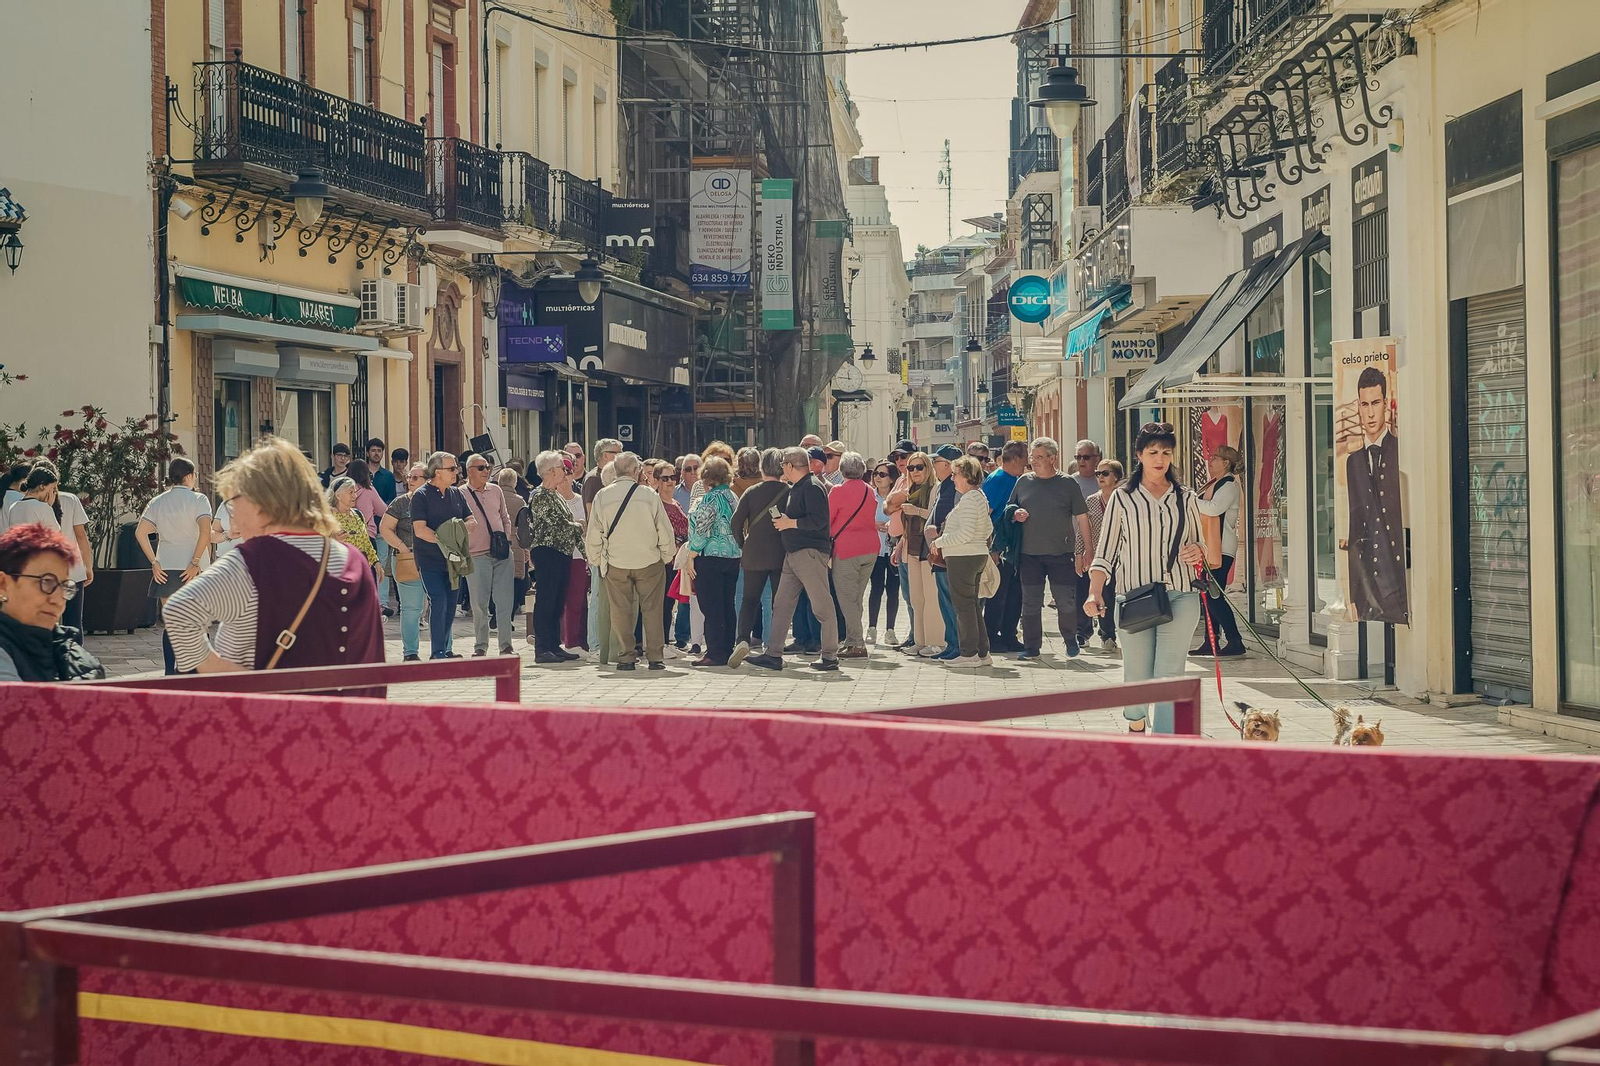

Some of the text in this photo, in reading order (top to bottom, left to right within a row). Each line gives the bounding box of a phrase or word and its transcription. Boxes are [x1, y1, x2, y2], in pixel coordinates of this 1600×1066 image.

[692, 274, 747, 282] 634 859 477
[212, 285, 243, 306] WELBA
[300, 301, 334, 323] NAZARET
[1112, 339, 1155, 348] MUNDO
[1112, 349, 1156, 359] MOVIL
[1342, 351, 1389, 365] celso prieto
